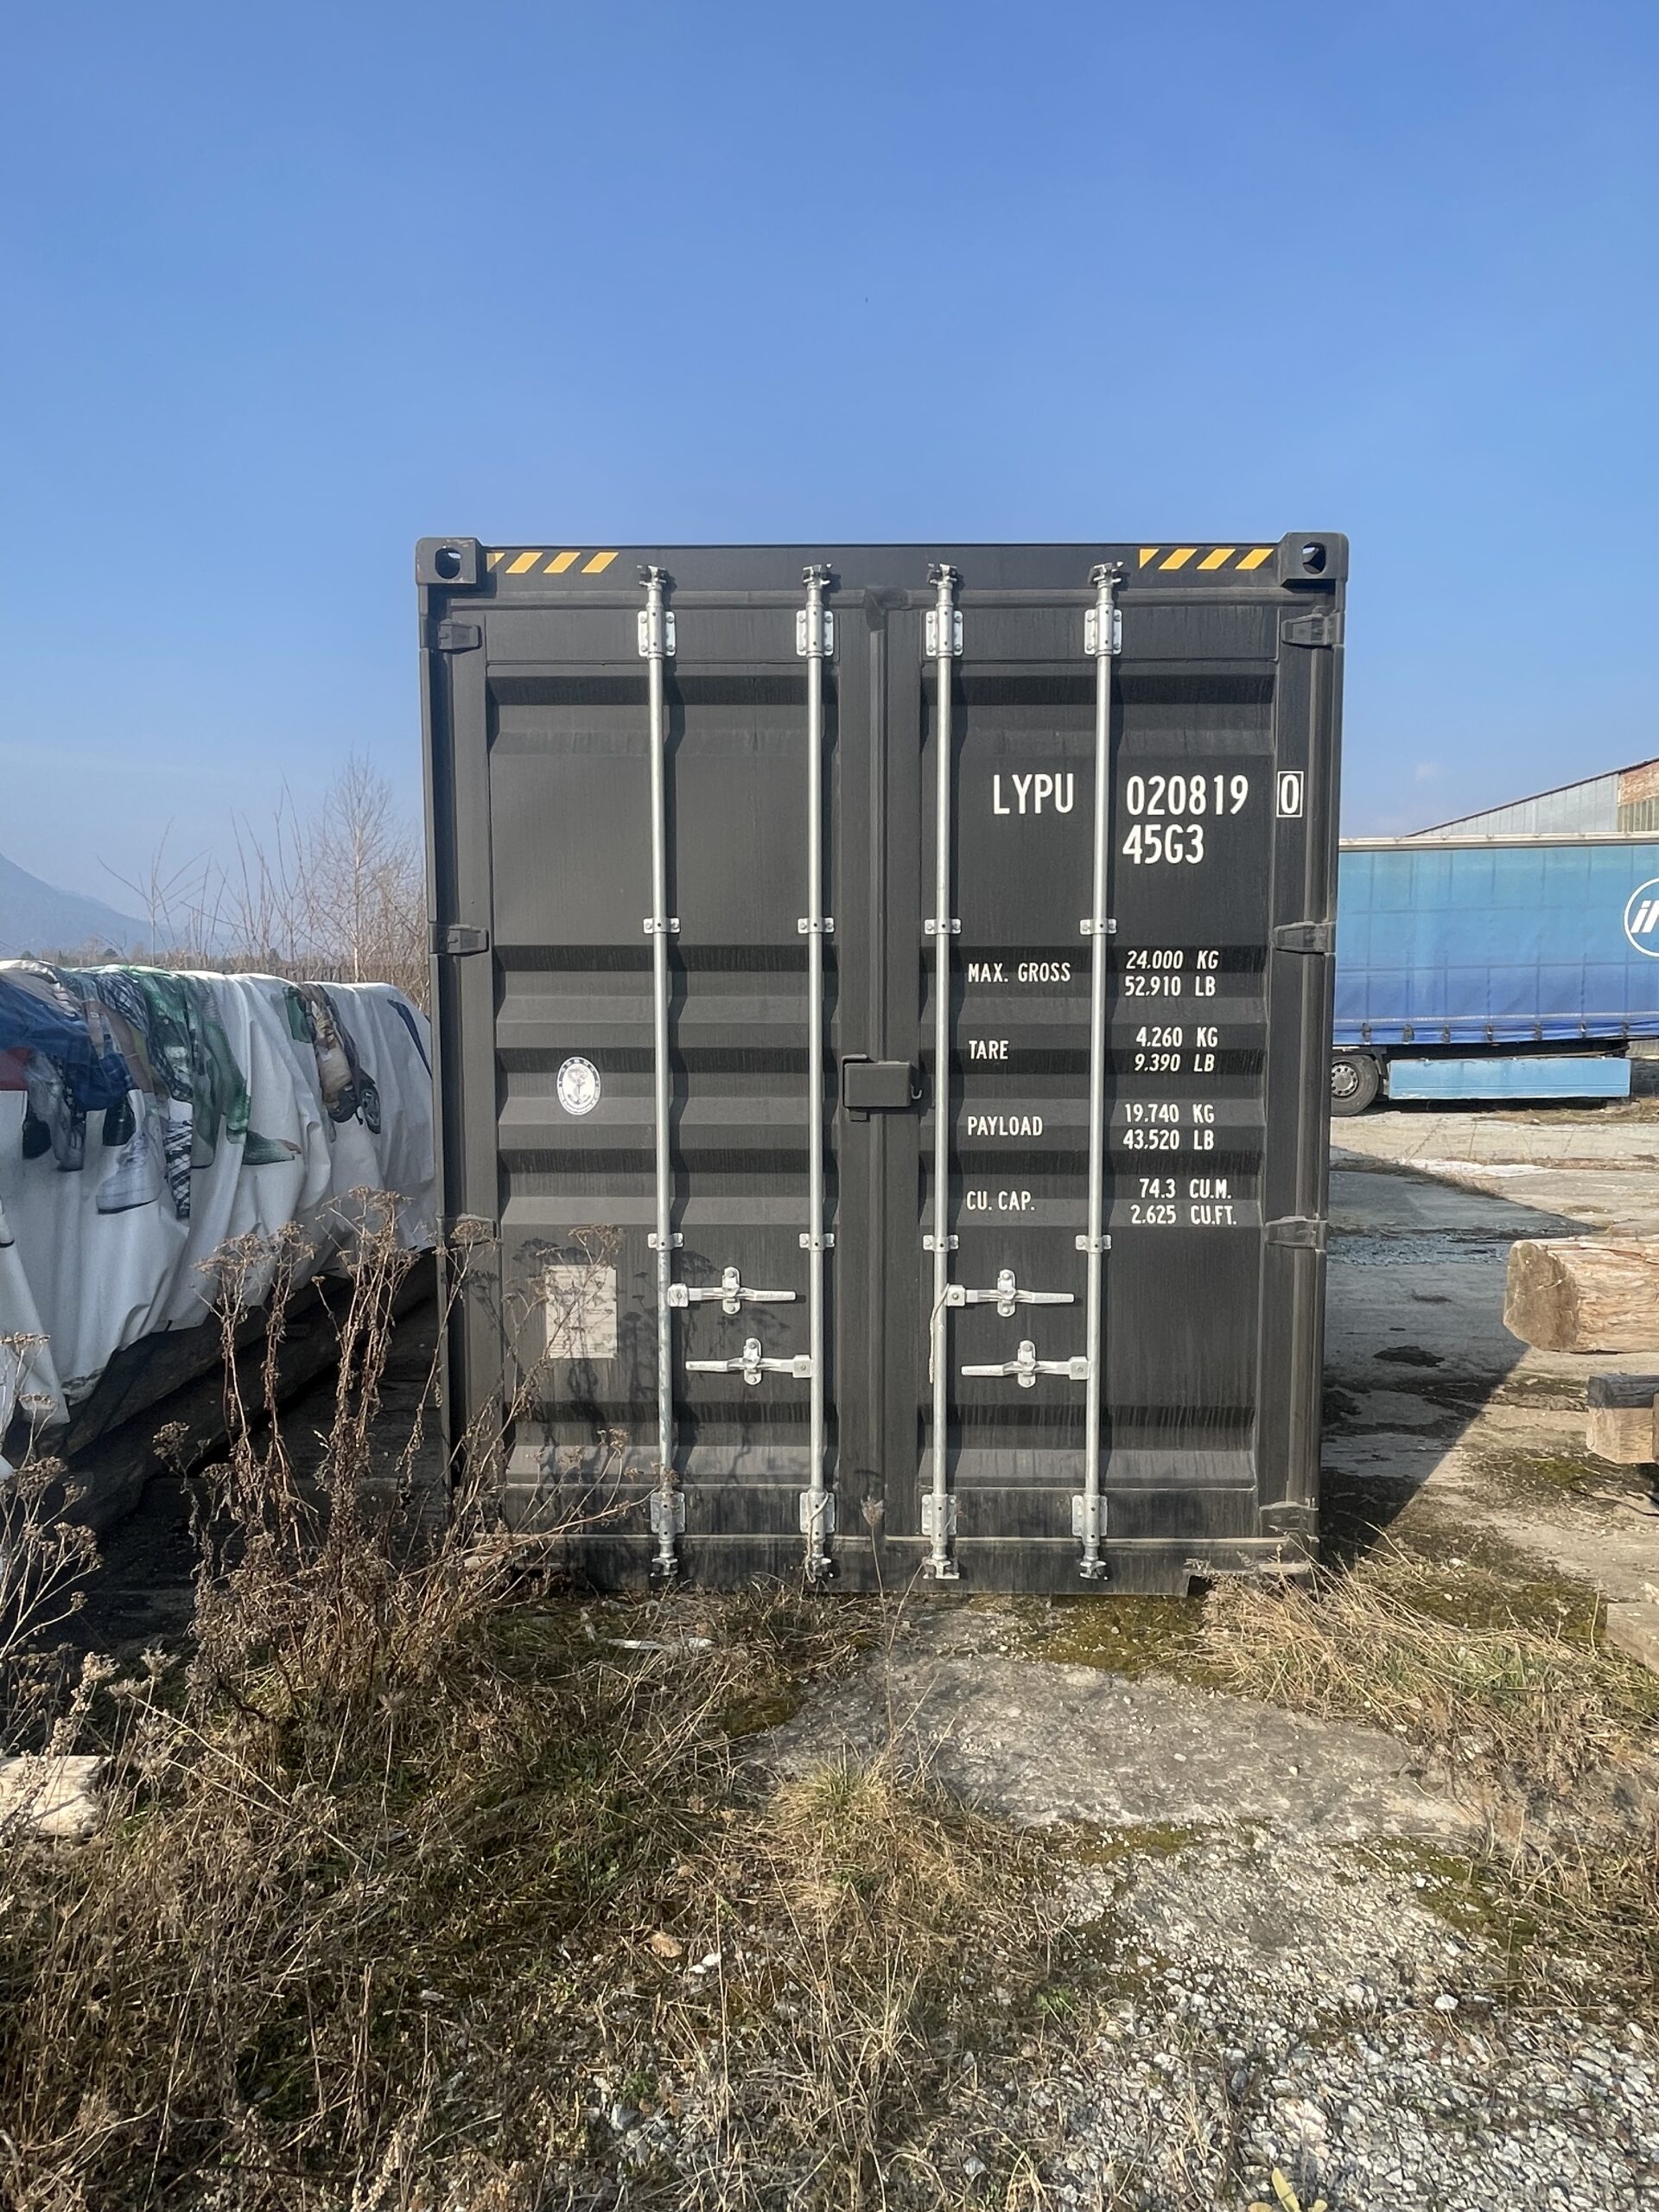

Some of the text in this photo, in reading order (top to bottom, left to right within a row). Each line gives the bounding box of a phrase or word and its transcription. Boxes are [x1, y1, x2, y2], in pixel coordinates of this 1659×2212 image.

[993, 772, 1298, 816] LYPU 020819 0
[1122, 823, 1205, 865] 45G3
[1196, 950, 1219, 969] KG
[968, 962, 1071, 982] MAX. GROSS
[1195, 976, 1216, 997] LB
[1196, 1027, 1218, 1048] KG
[969, 1039, 1010, 1060] TARE
[1193, 1053, 1215, 1072] LB
[1192, 1103, 1215, 1124] KG
[967, 1116, 1043, 1136] PAYLOAD
[1193, 1129, 1214, 1151] LB
[1139, 1178, 1176, 1199] 74.3
[997, 1191, 1035, 1211] CAP.
